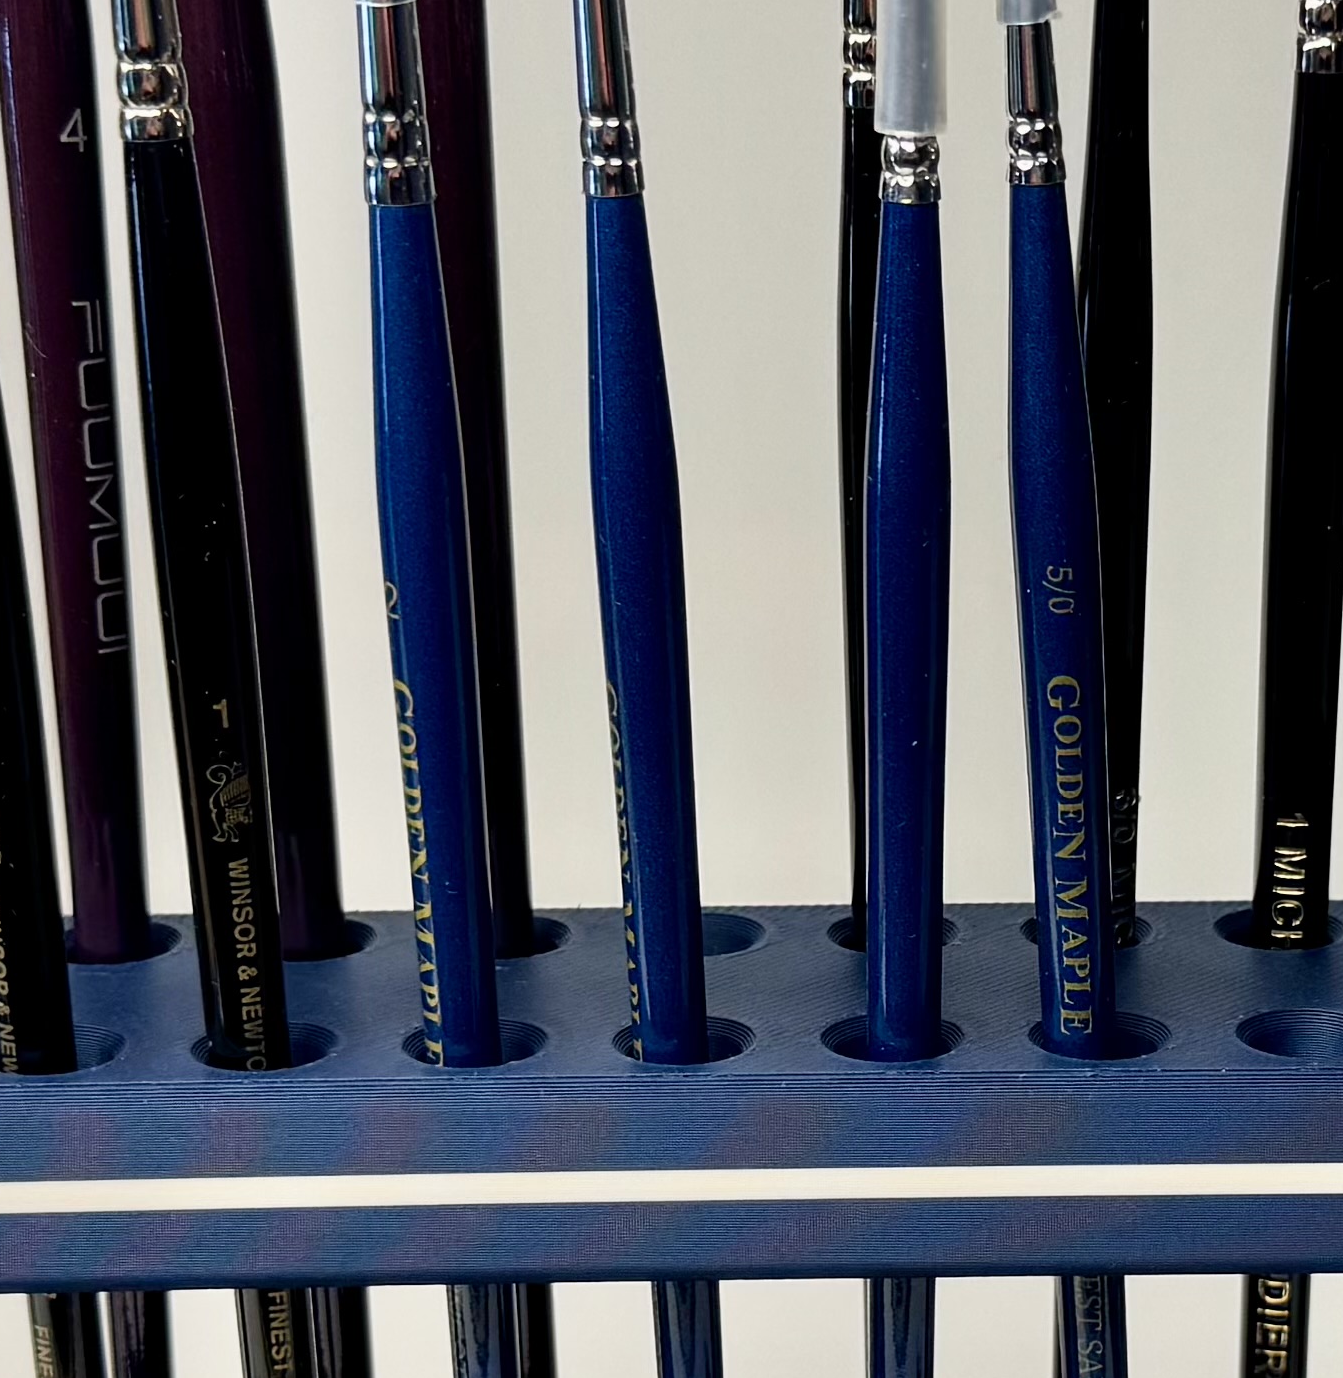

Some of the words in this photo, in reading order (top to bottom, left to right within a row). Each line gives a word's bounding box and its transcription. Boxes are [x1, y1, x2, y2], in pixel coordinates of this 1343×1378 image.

[60, 109, 88, 153] 4
[1042, 564, 1074, 615] 5/0
[212, 699, 229, 728] 1
[1046, 675, 1087, 862] GOLDEN
[228, 857, 257, 959] WINSOR
[238, 964, 258, 981] &
[1054, 876, 1093, 1037] MAPLE
[268, 1290, 295, 1372] FINEST
